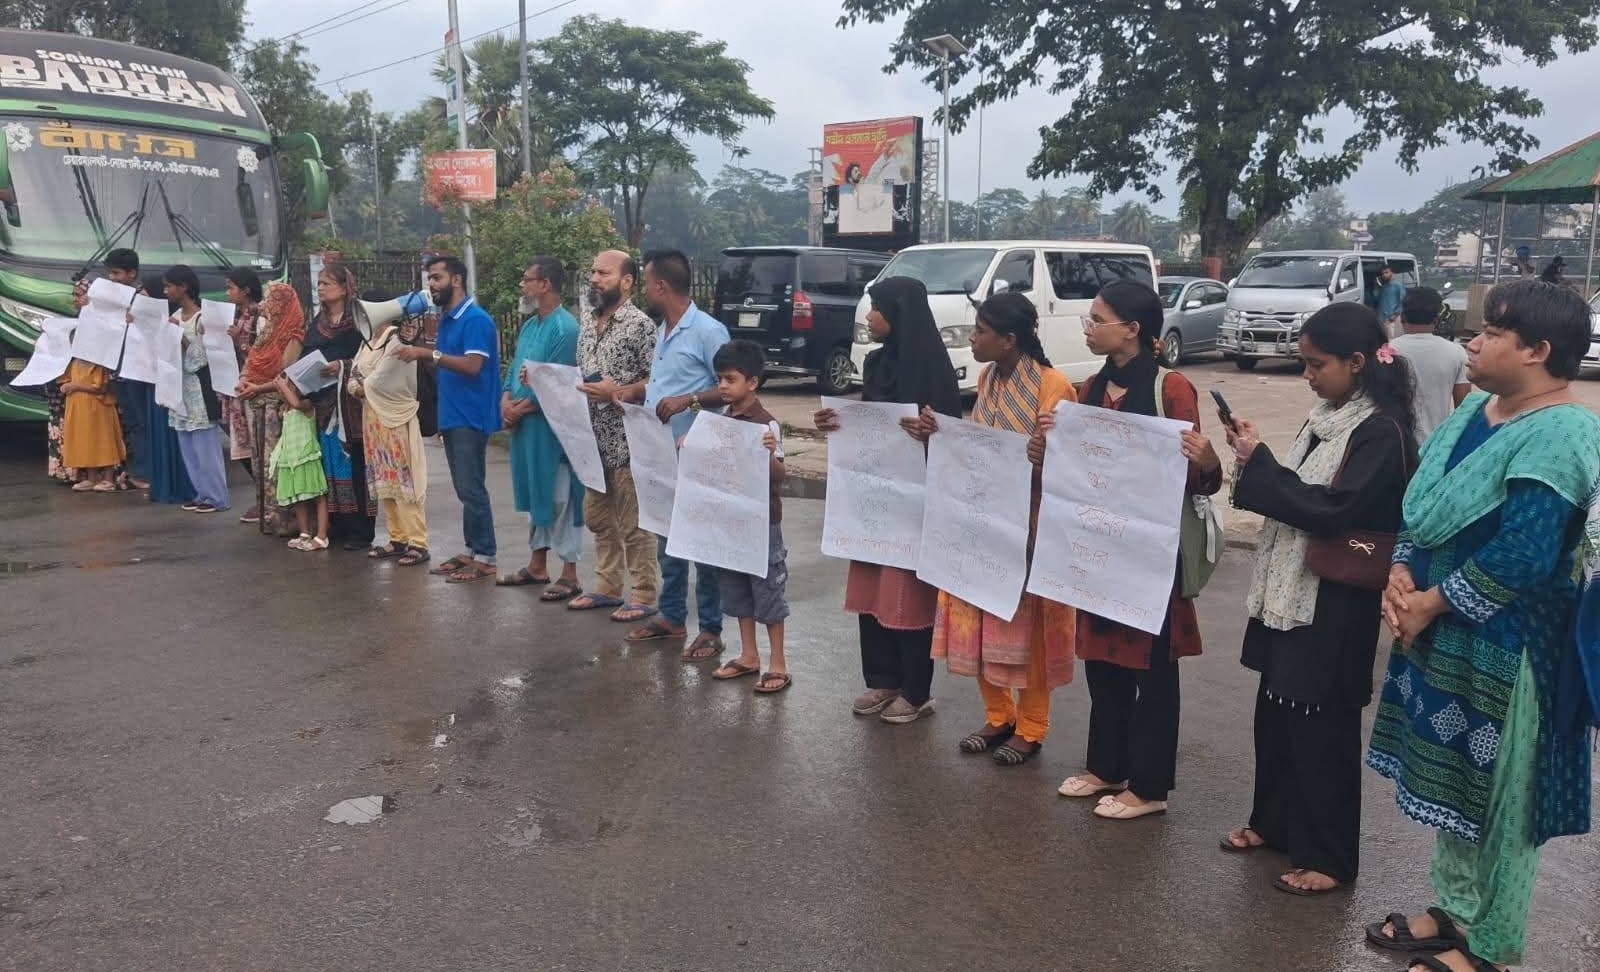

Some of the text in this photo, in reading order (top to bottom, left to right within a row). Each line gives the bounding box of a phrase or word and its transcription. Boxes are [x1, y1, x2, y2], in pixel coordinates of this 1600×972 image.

[0, 53, 248, 118] BADHAN
[35, 49, 188, 80] SOBHAN ALLAH
